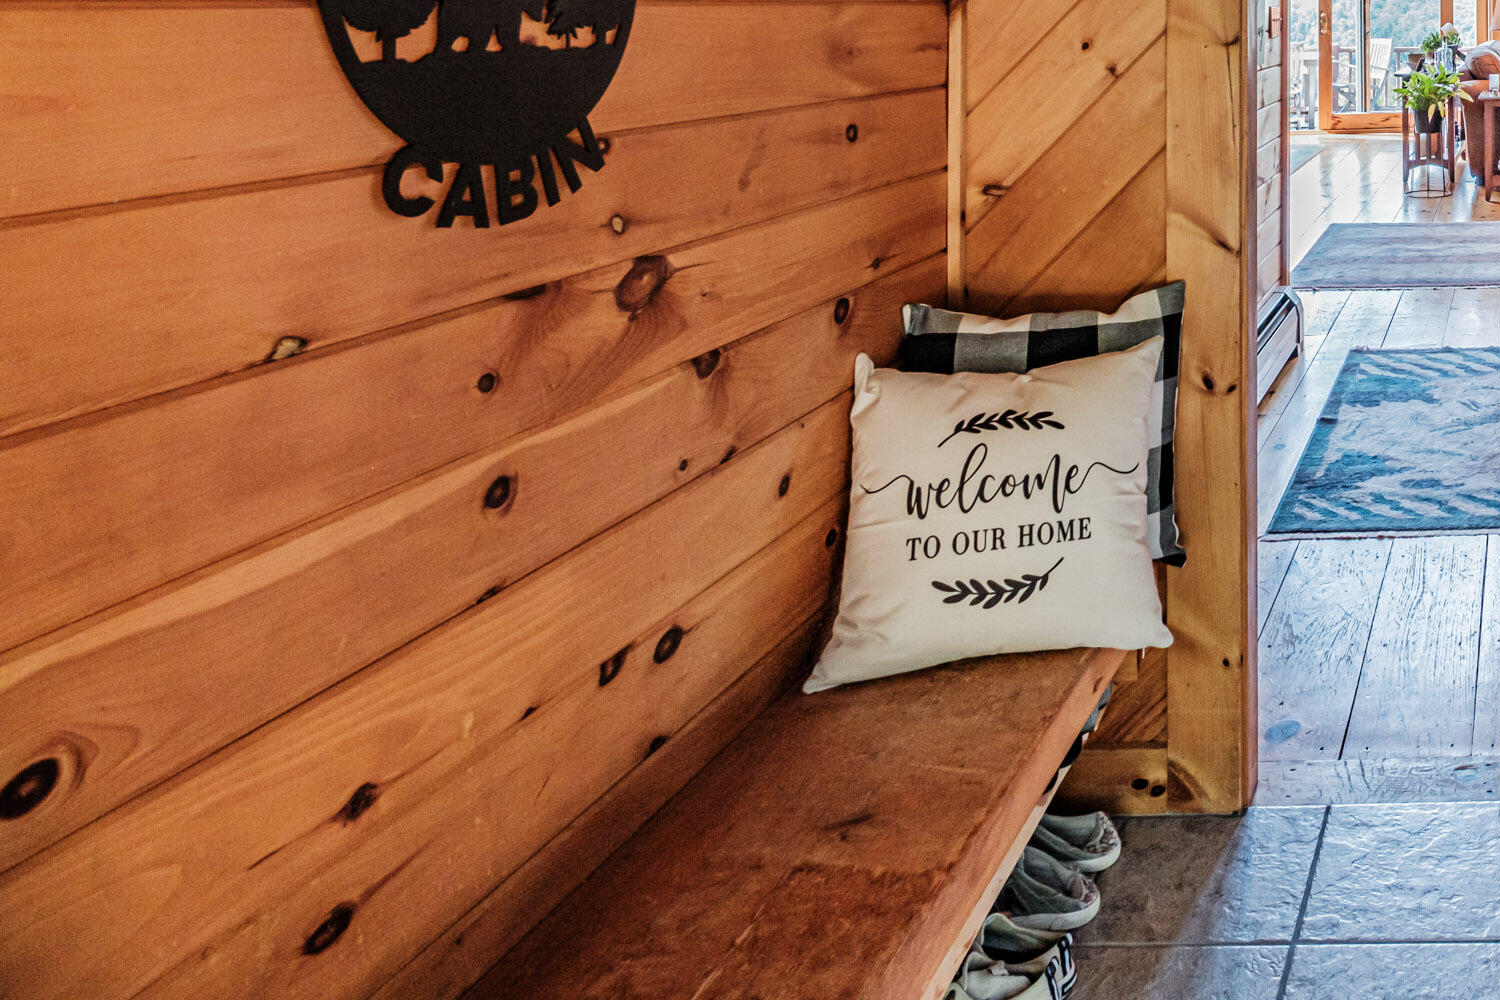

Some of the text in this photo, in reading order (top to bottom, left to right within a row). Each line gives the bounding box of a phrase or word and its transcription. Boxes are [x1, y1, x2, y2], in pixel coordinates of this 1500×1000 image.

[382, 112, 606, 228] CABIN
[859, 443, 1139, 520] welcome
[906, 516, 1092, 561] TO OUR HOME
